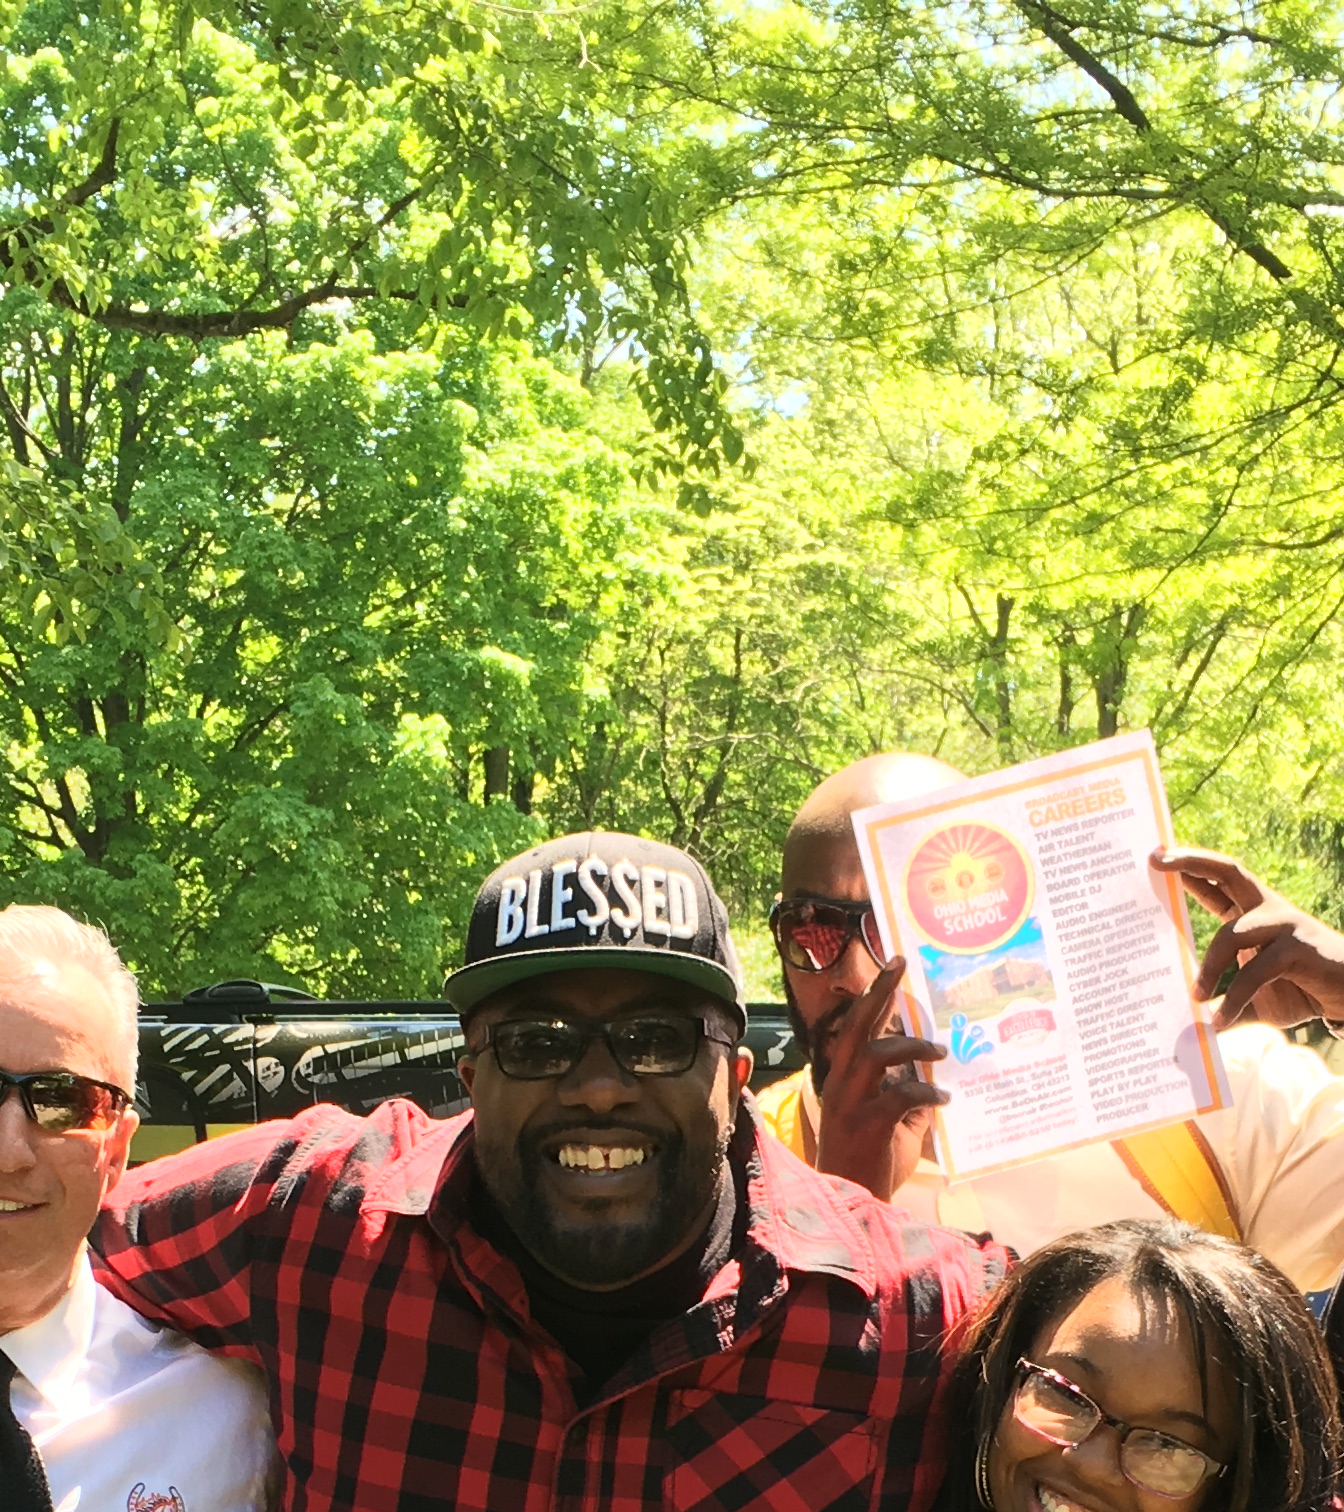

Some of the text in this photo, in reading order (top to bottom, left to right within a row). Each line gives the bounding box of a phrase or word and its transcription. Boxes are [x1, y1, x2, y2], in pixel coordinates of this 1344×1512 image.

[1088, 778, 1120, 792] MEDIA
[1029, 788, 1125, 826] CAREERS
[1034, 808, 1134, 841] TV NEWS REPORTER
[1038, 831, 1095, 854] AIR TALENT
[1040, 841, 1111, 867] WEATHERMAN
[1042, 849, 1131, 879] TV NEWS ANCHOR
[1046, 861, 1135, 892] BOARD OPERATOR
[934, 889, 1008, 919] OHIO MEDIA
[1049, 884, 1102, 905] MOBILE DJ
[944, 906, 1006, 934] SCHOOL
[1051, 901, 1089, 918] EDITOR
[1056, 899, 1137, 930] AUDIO ENGINEER
[1058, 904, 1163, 941] TECHNICAL DIRECTOR
[1061, 919, 1155, 954] CAMERA OPERATOR
[1064, 933, 1155, 966] TRAFFIC REPORTER
[1067, 944, 1159, 979] AUDIO PRODUCTION
[1069, 967, 1128, 992] CYBER JOCK
[1072, 966, 1171, 1004] ACCOUNT EXECUTIVE
[1074, 992, 1128, 1016] SHOW HOST
[1076, 994, 1164, 1028] TRAFFIC DIRECTOR
[1078, 1012, 1144, 1040] VOICE TALENT
[1081, 1021, 1157, 1051] NEWS DIRECTOR
[1083, 1038, 1146, 1063] PROMOTIONS
[1085, 1047, 1159, 1075] VIDEOGRAPHER
[1031, 1081, 1045, 1091] OH
[1088, 1070, 1125, 1087] SPORTS
[1090, 1073, 1157, 1099] PLAY BY PLAY
[1092, 1079, 1188, 1111] VIDEO PRODUCTION
[1096, 1102, 1148, 1123] PRODUCER
